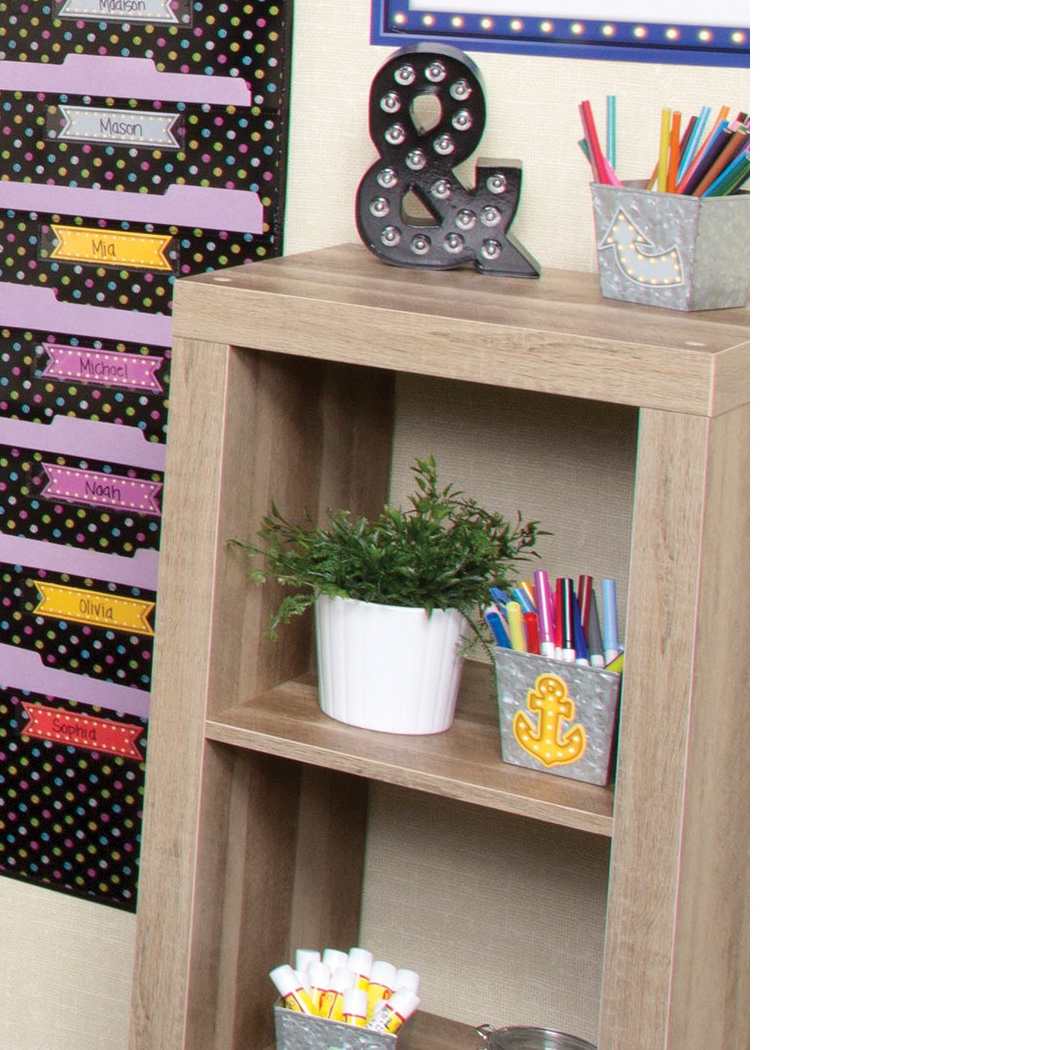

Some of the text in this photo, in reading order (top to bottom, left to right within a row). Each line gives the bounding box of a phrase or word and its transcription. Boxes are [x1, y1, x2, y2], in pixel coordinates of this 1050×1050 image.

[100, 118, 143, 136] Mason
[92, 239, 115, 257] Mia
[80, 357, 128, 379] Michael
[85, 481, 120, 499] Noah
[79, 599, 113, 620] Olivia
[52, 720, 96, 741] Sophia
